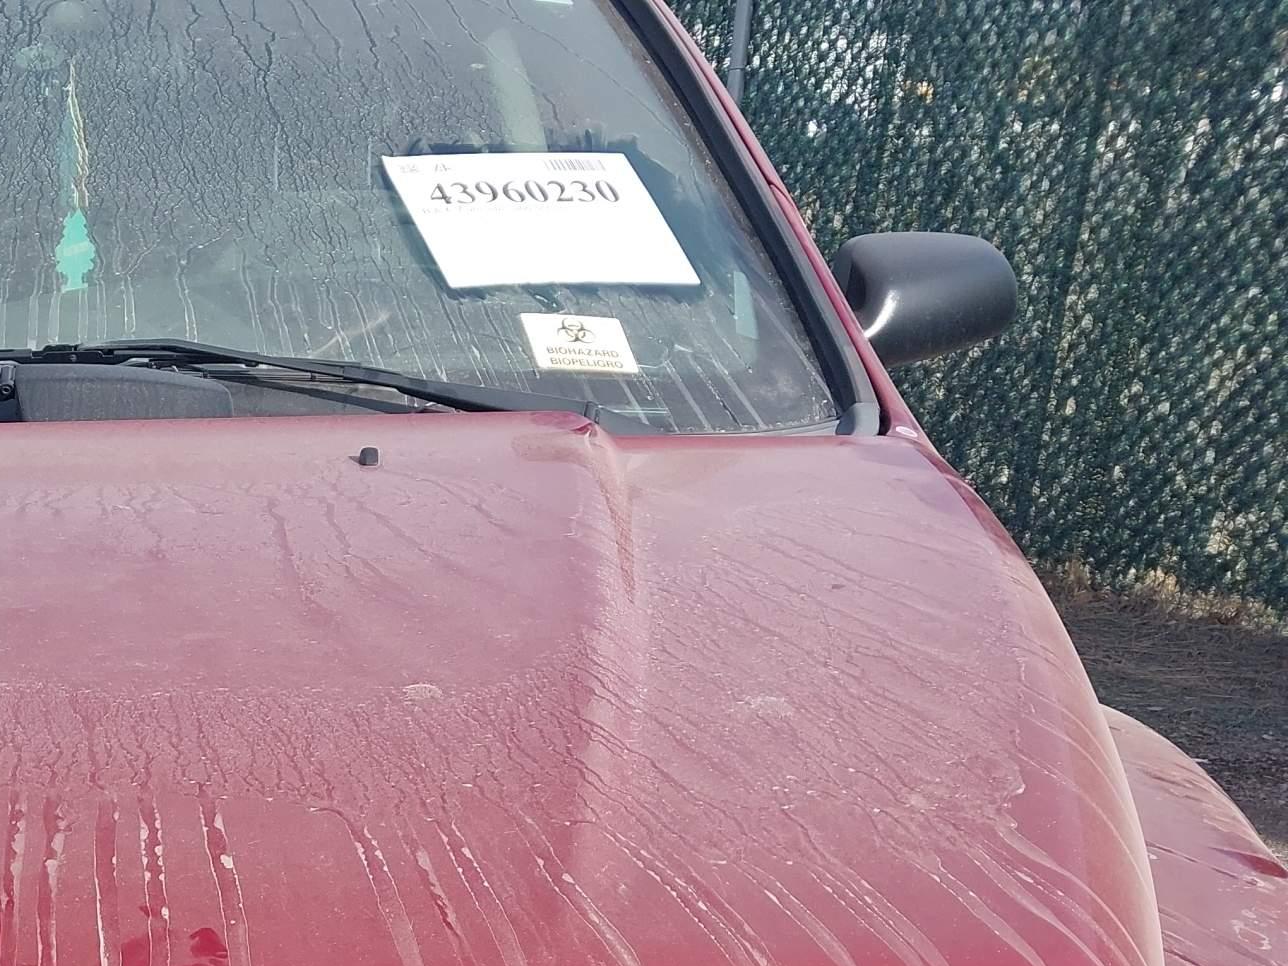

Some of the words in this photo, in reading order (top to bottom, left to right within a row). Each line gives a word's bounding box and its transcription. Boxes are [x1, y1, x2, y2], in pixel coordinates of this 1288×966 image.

[430, 180, 621, 204] 43960230
[546, 345, 619, 358] BIOHAZARD
[549, 356, 624, 369] BIOPELIGRO
